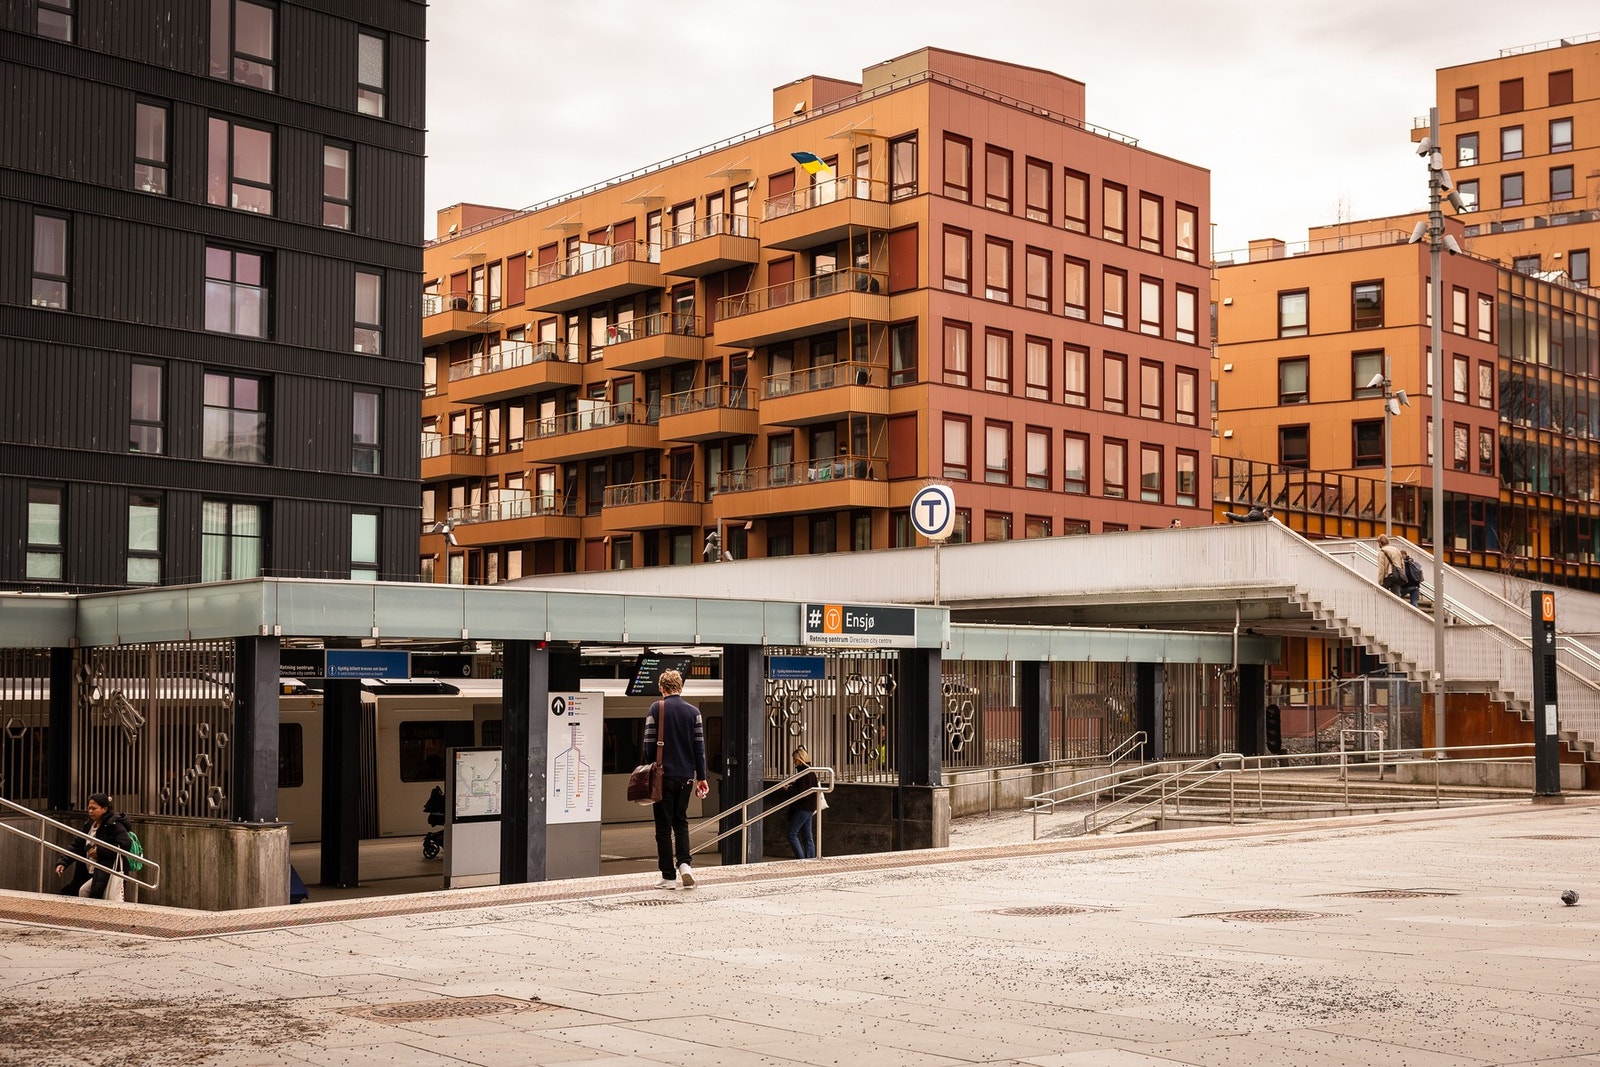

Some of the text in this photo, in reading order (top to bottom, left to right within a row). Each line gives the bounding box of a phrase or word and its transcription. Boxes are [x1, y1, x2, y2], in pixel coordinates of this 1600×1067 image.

[921, 499, 941, 527] T
[846, 612, 875, 632] Ensjø
[809, 635, 828, 644] Retning
[828, 636, 849, 644] sentrum
[849, 636, 869, 644] Direction
[869, 637, 878, 646] city
